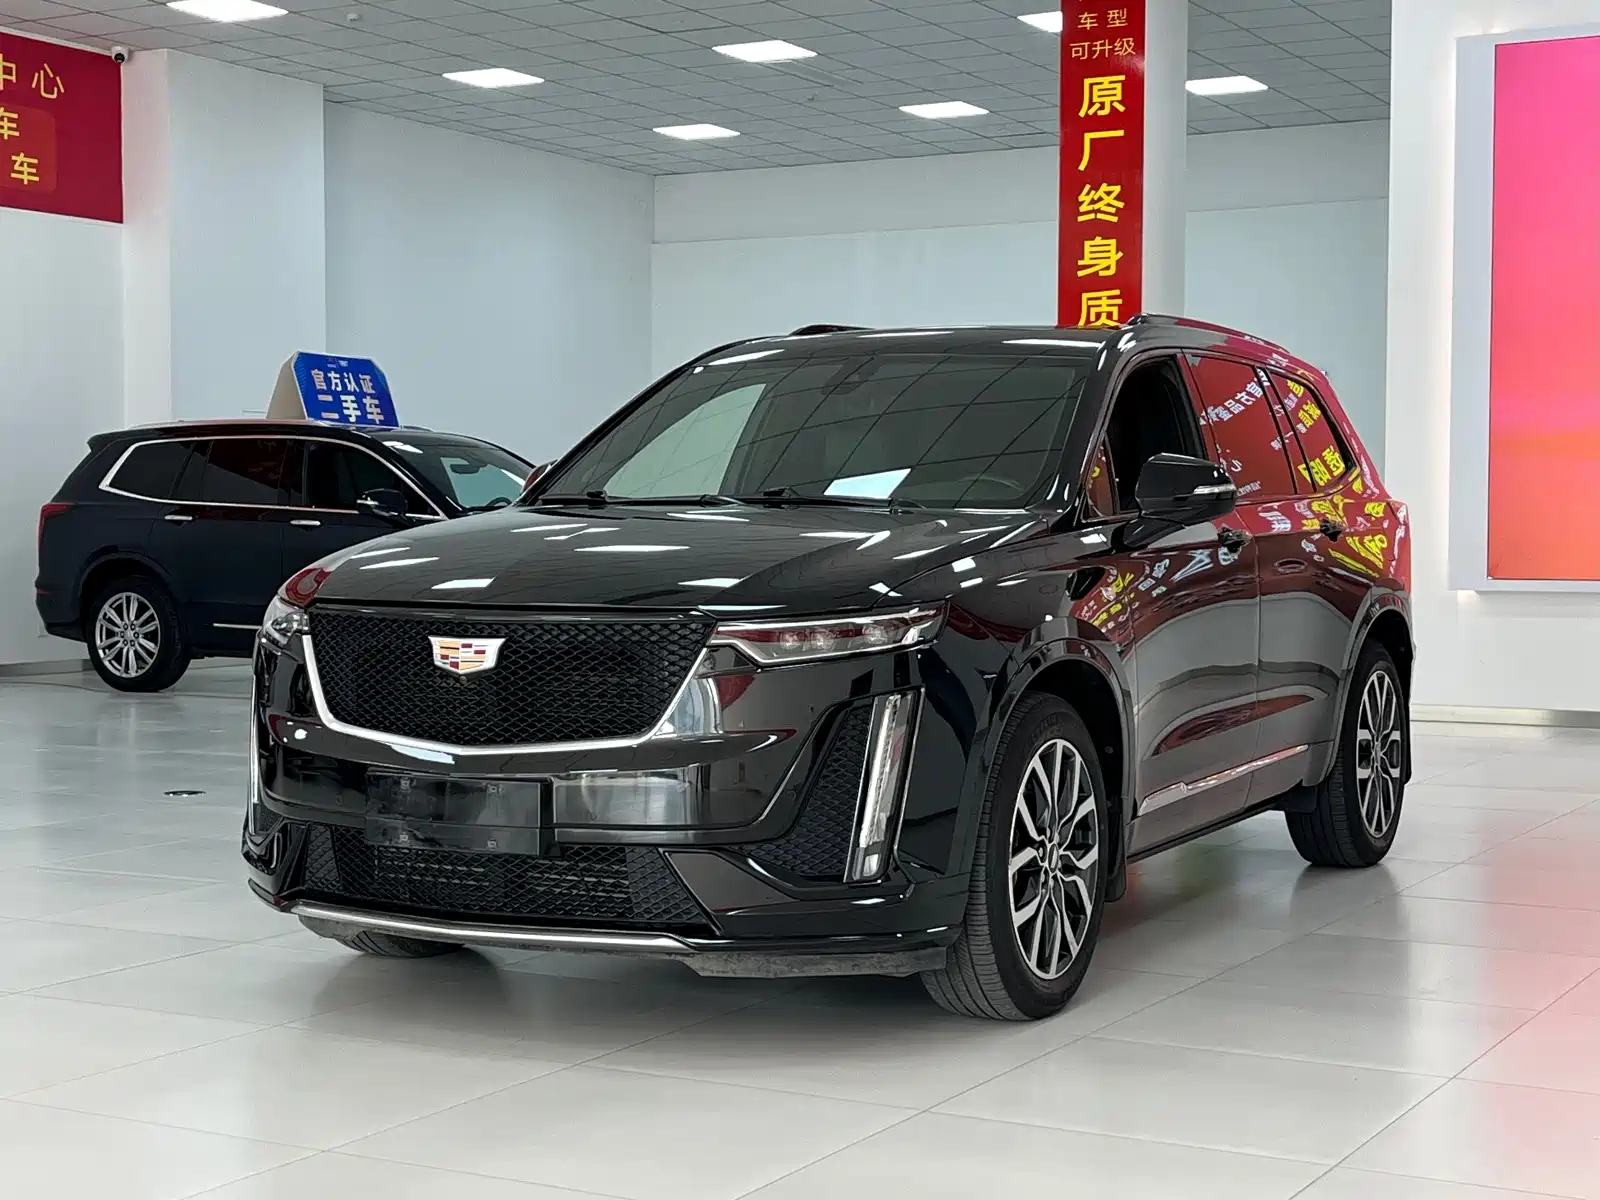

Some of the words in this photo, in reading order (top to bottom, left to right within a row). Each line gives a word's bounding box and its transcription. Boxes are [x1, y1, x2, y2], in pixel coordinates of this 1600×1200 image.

[1077, 8, 1128, 31] 车型
[1069, 38, 1136, 60] 可升级
[11, 152, 40, 185] 车
[1077, 75, 1126, 327] 原厂终身质
[311, 369, 376, 394] 官方认证
[317, 393, 384, 425] 二手车
